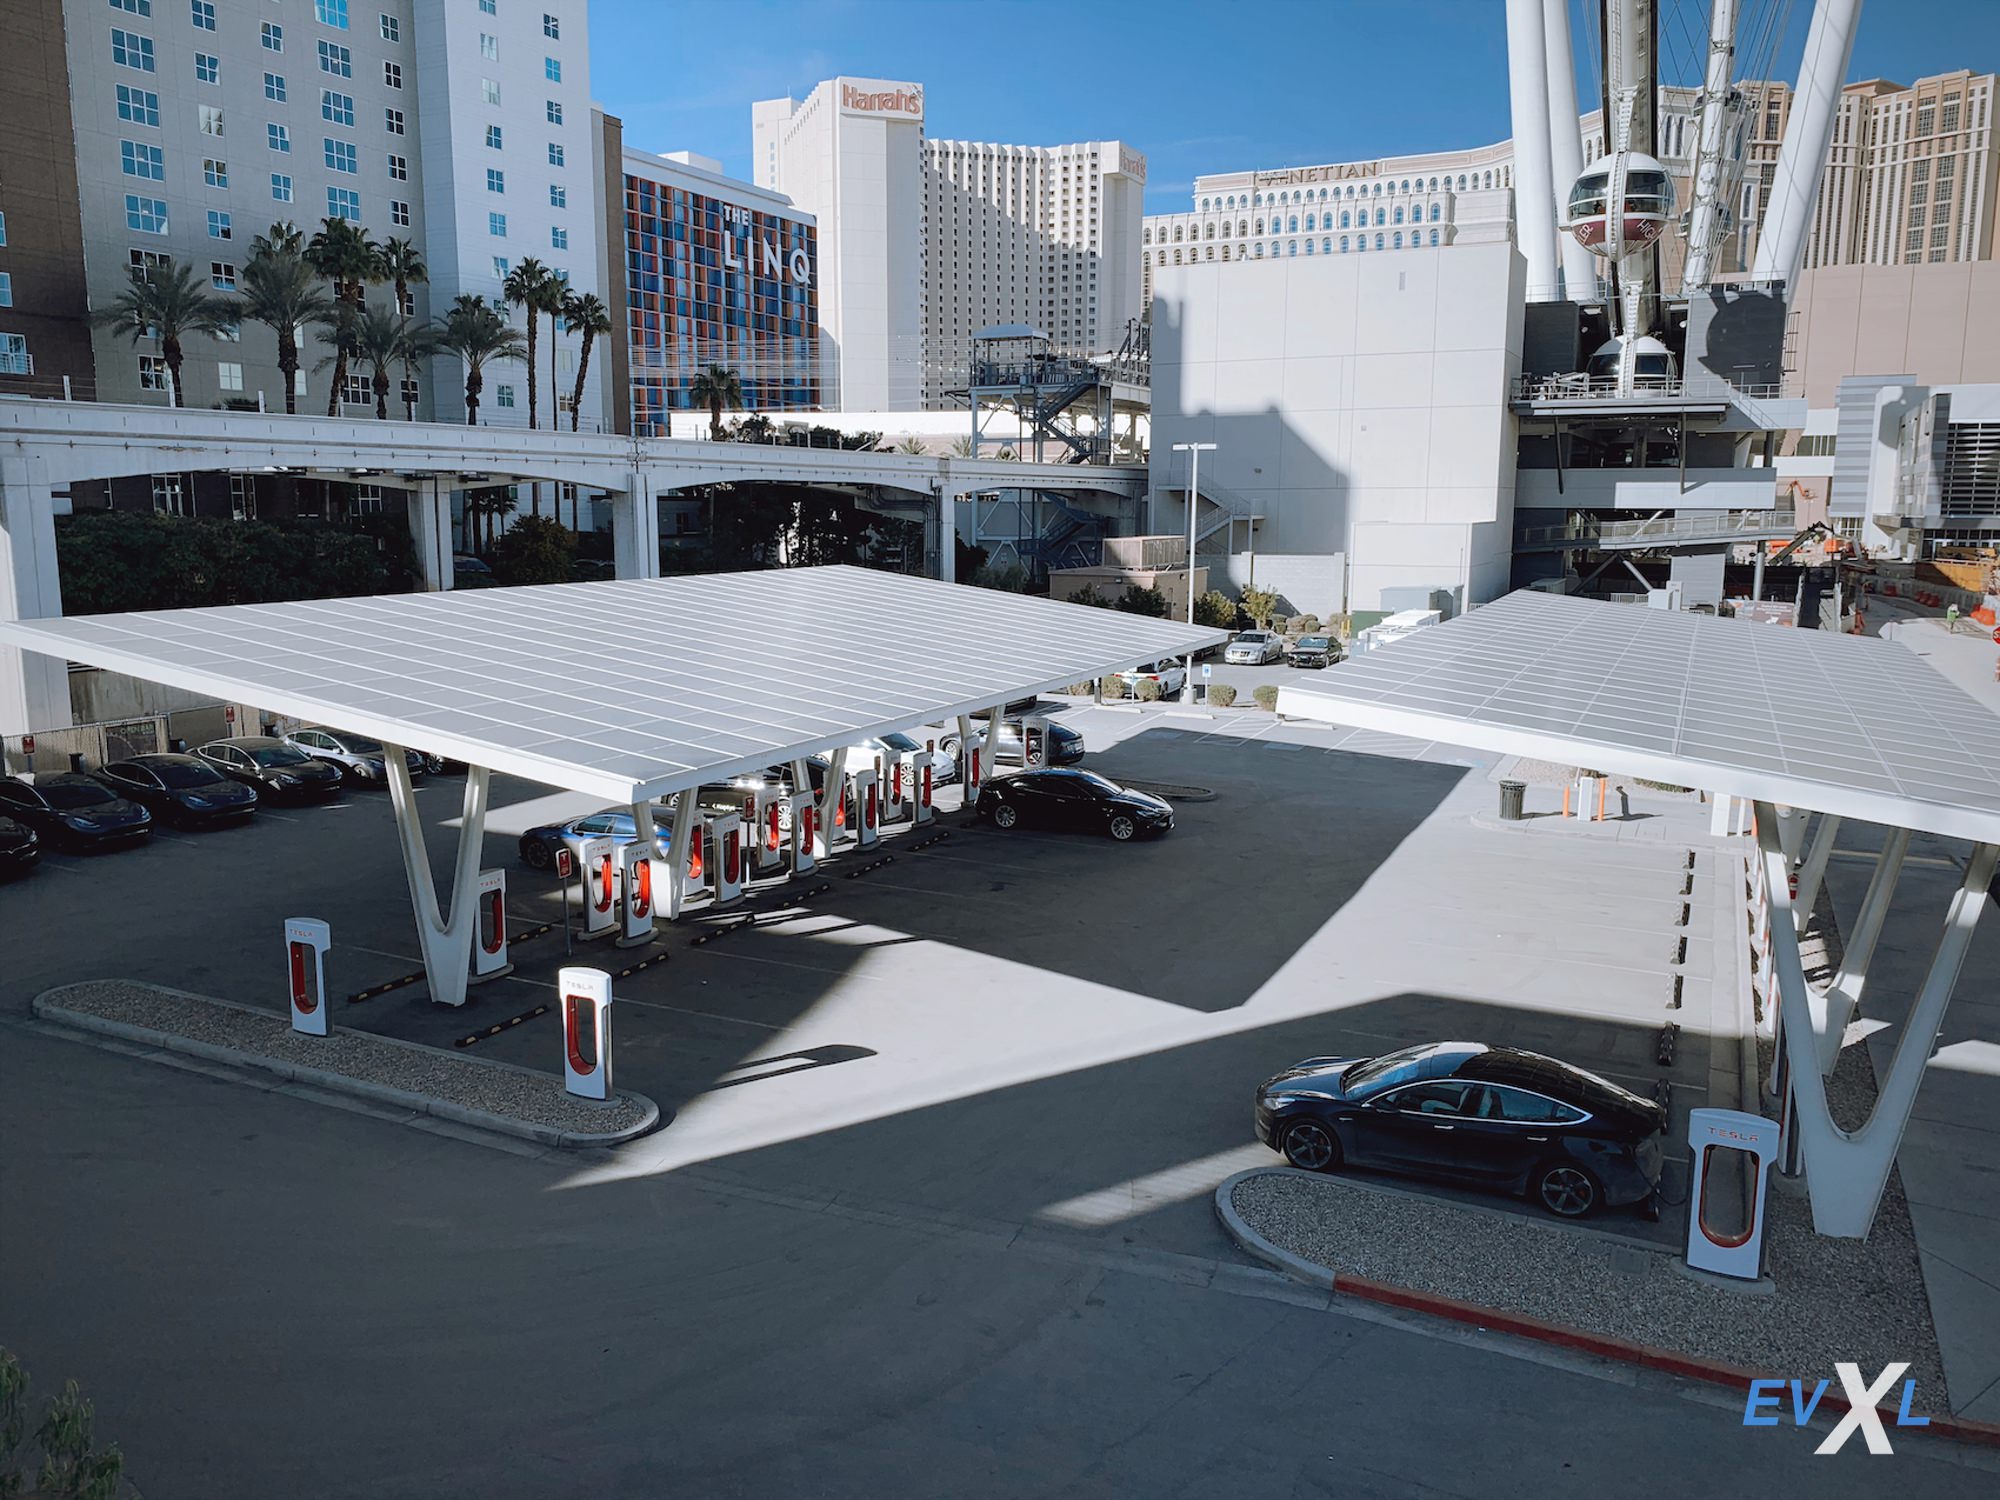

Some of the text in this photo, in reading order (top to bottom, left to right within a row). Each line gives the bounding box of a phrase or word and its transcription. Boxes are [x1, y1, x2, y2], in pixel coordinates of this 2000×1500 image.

[724, 205, 749, 226] THE
[724, 230, 811, 285] LINQ
[290, 928, 314, 937] TESLA
[566, 980, 594, 991] TESLA
[1708, 1126, 1758, 1142] TESLA
